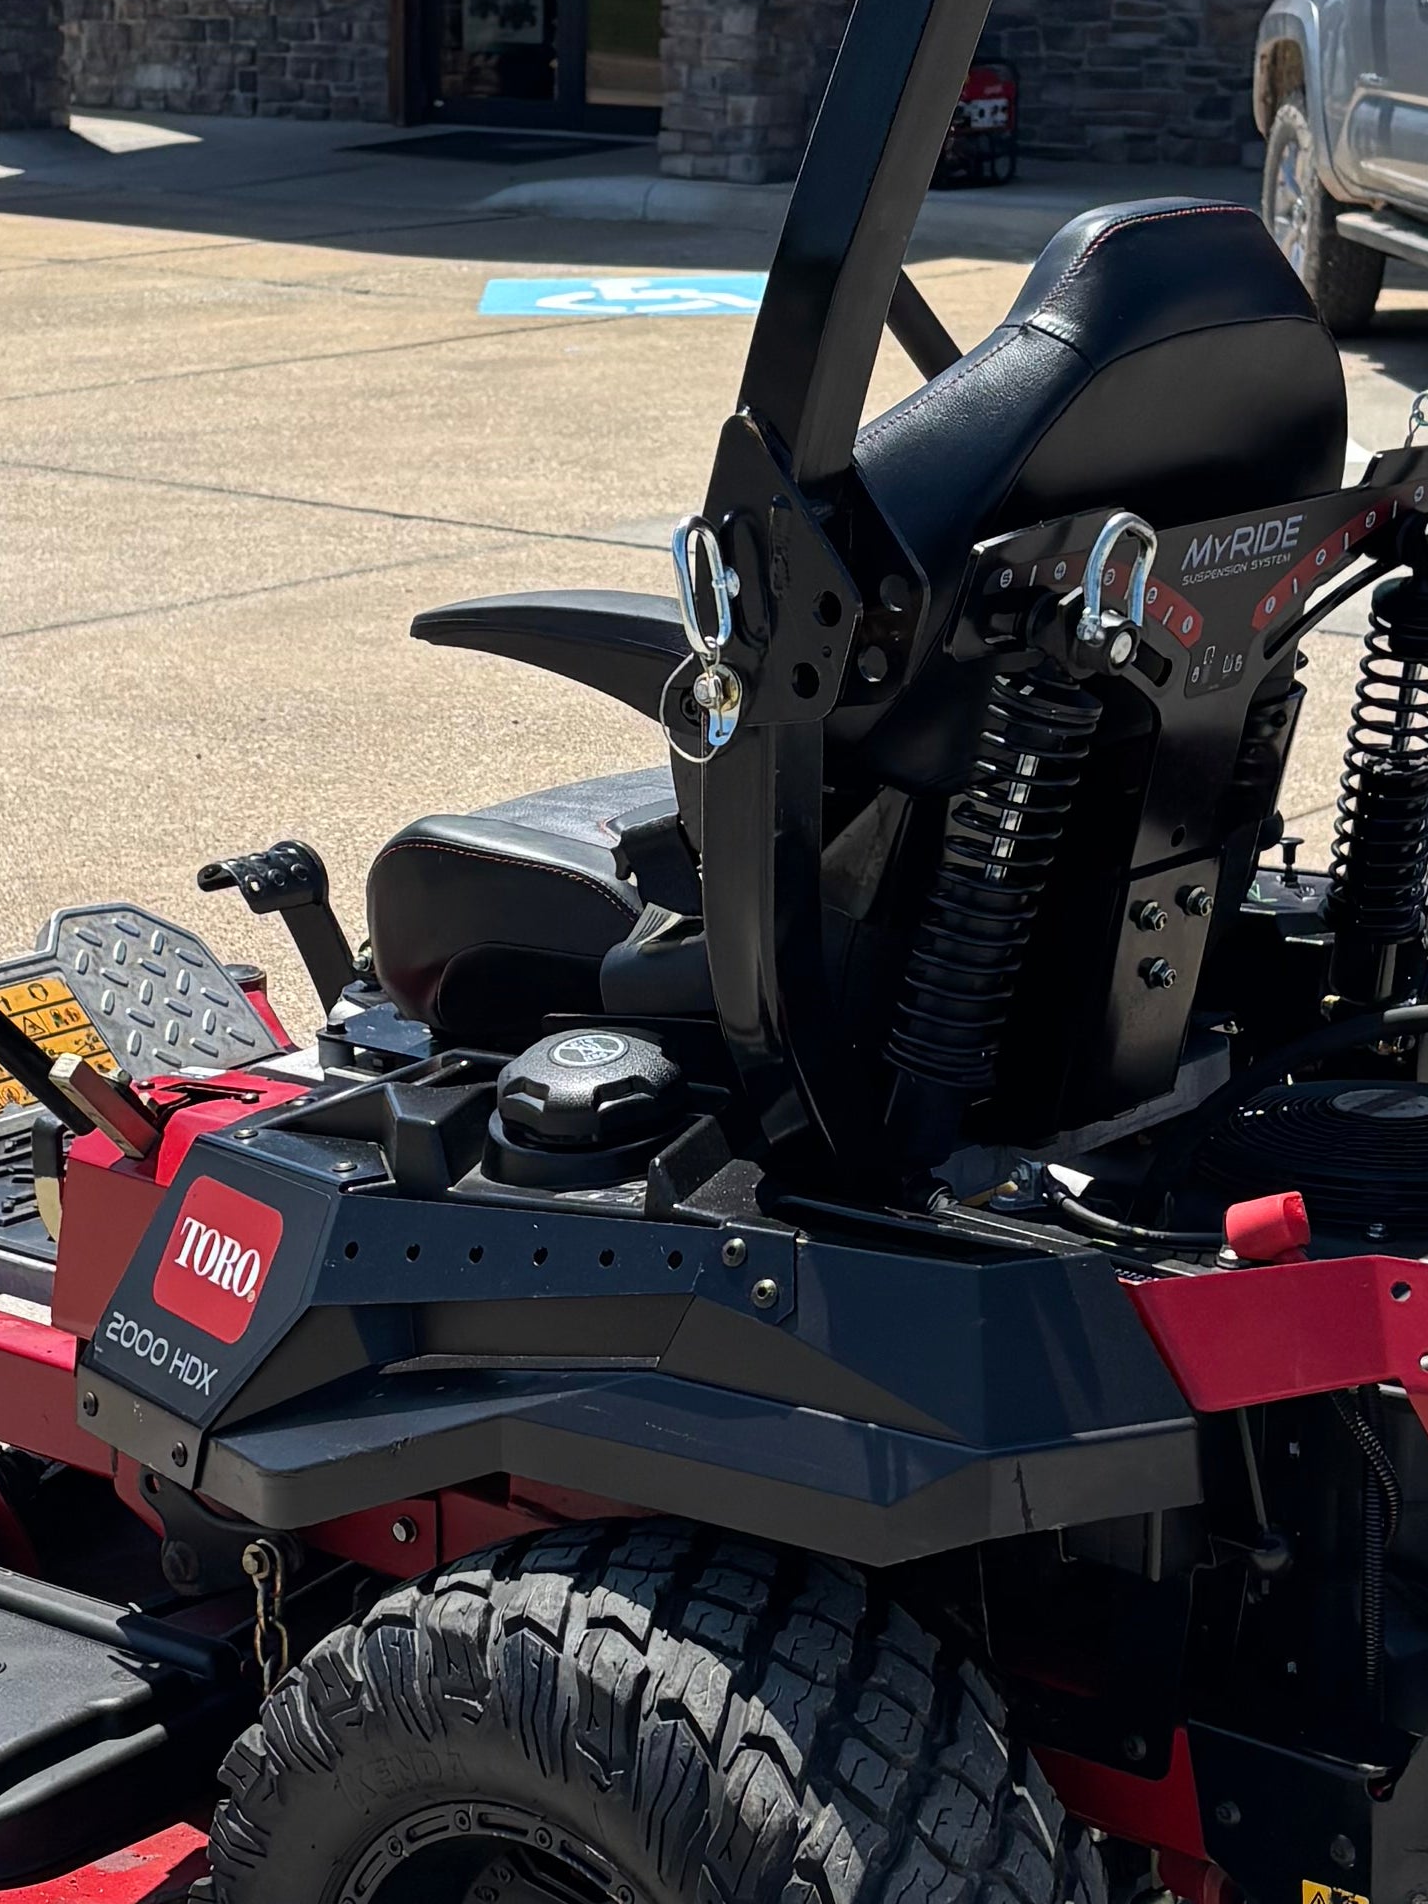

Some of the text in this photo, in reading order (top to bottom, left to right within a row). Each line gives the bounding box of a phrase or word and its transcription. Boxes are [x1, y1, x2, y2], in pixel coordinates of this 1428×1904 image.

[174, 1216, 261, 1298] TORO
[105, 1311, 219, 1396] 2000 HDX
